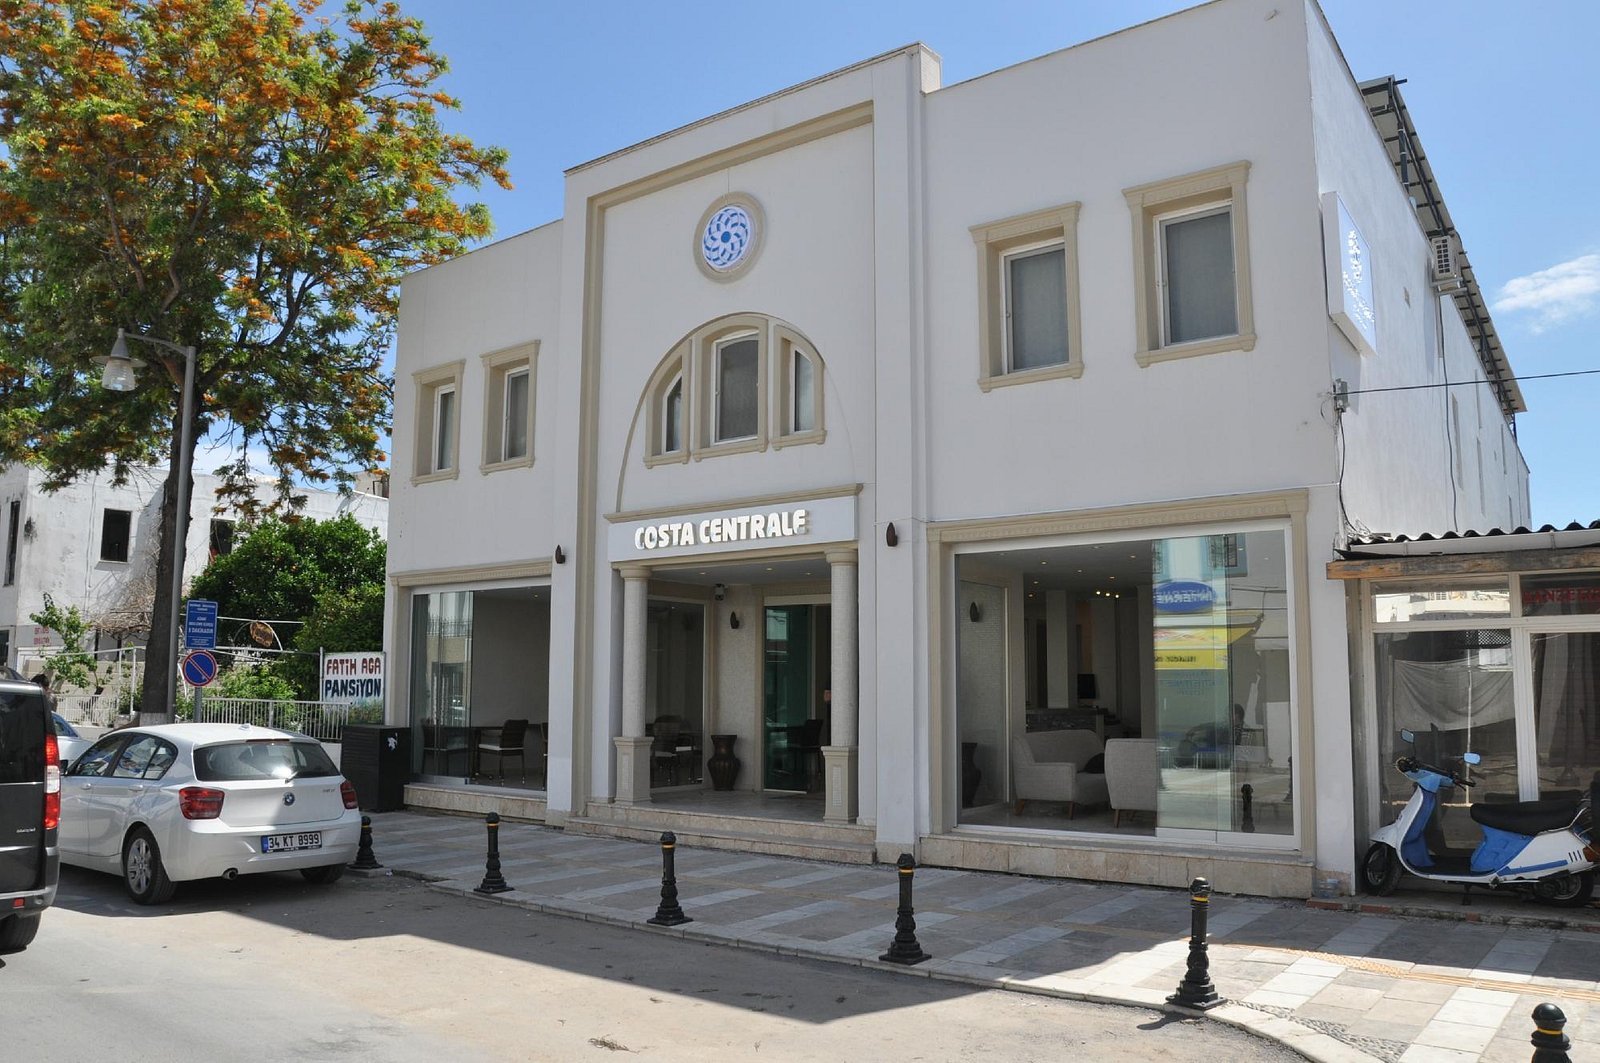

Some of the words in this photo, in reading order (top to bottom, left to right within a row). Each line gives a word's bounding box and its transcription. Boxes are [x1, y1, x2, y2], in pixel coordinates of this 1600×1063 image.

[634, 522, 695, 549] COSTA
[699, 509, 808, 544] CENTRALE
[269, 837, 279, 848] 34
[283, 835, 294, 847] KT
[298, 833, 319, 845] 8999
